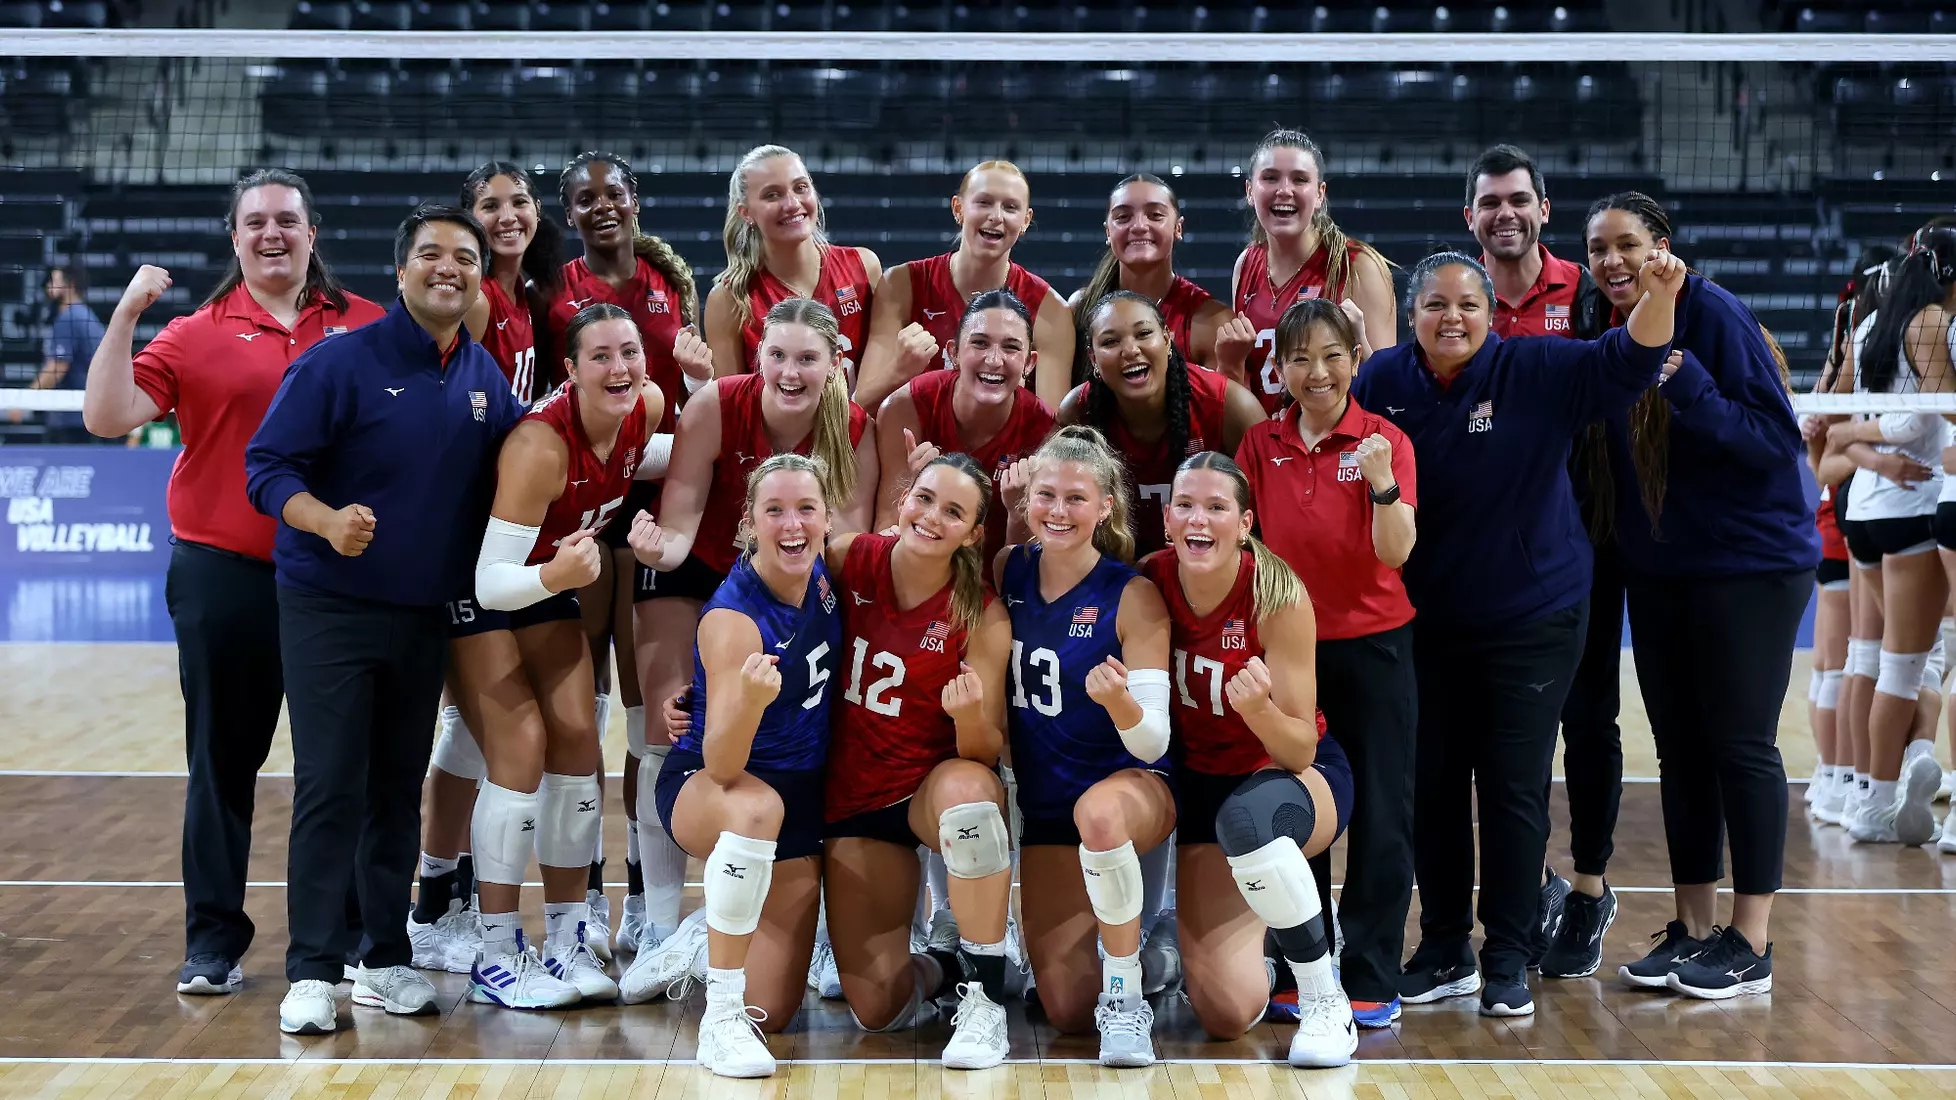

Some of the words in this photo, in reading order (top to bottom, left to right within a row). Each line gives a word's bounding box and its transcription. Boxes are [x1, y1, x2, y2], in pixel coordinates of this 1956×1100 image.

[647, 301, 670, 314] USA
[840, 300, 862, 317] USA
[1544, 318, 1570, 331] USA
[511, 346, 535, 408] 10
[471, 407, 486, 423] US
[1468, 417, 1493, 434] USA
[37, 466, 94, 498] ARE
[1337, 467, 1363, 482] USA
[7, 497, 53, 524] USA
[17, 523, 153, 552] VOLLEYBALL
[642, 567, 656, 590] 11
[445, 598, 476, 625] 15
[822, 591, 837, 615] USA
[1069, 623, 1092, 638] USA
[919, 636, 945, 654] USA
[1222, 636, 1247, 650] USA
[801, 640, 831, 710] 5
[844, 636, 907, 717] 12
[1011, 639, 1063, 717] 13
[1174, 648, 1225, 716] 17
